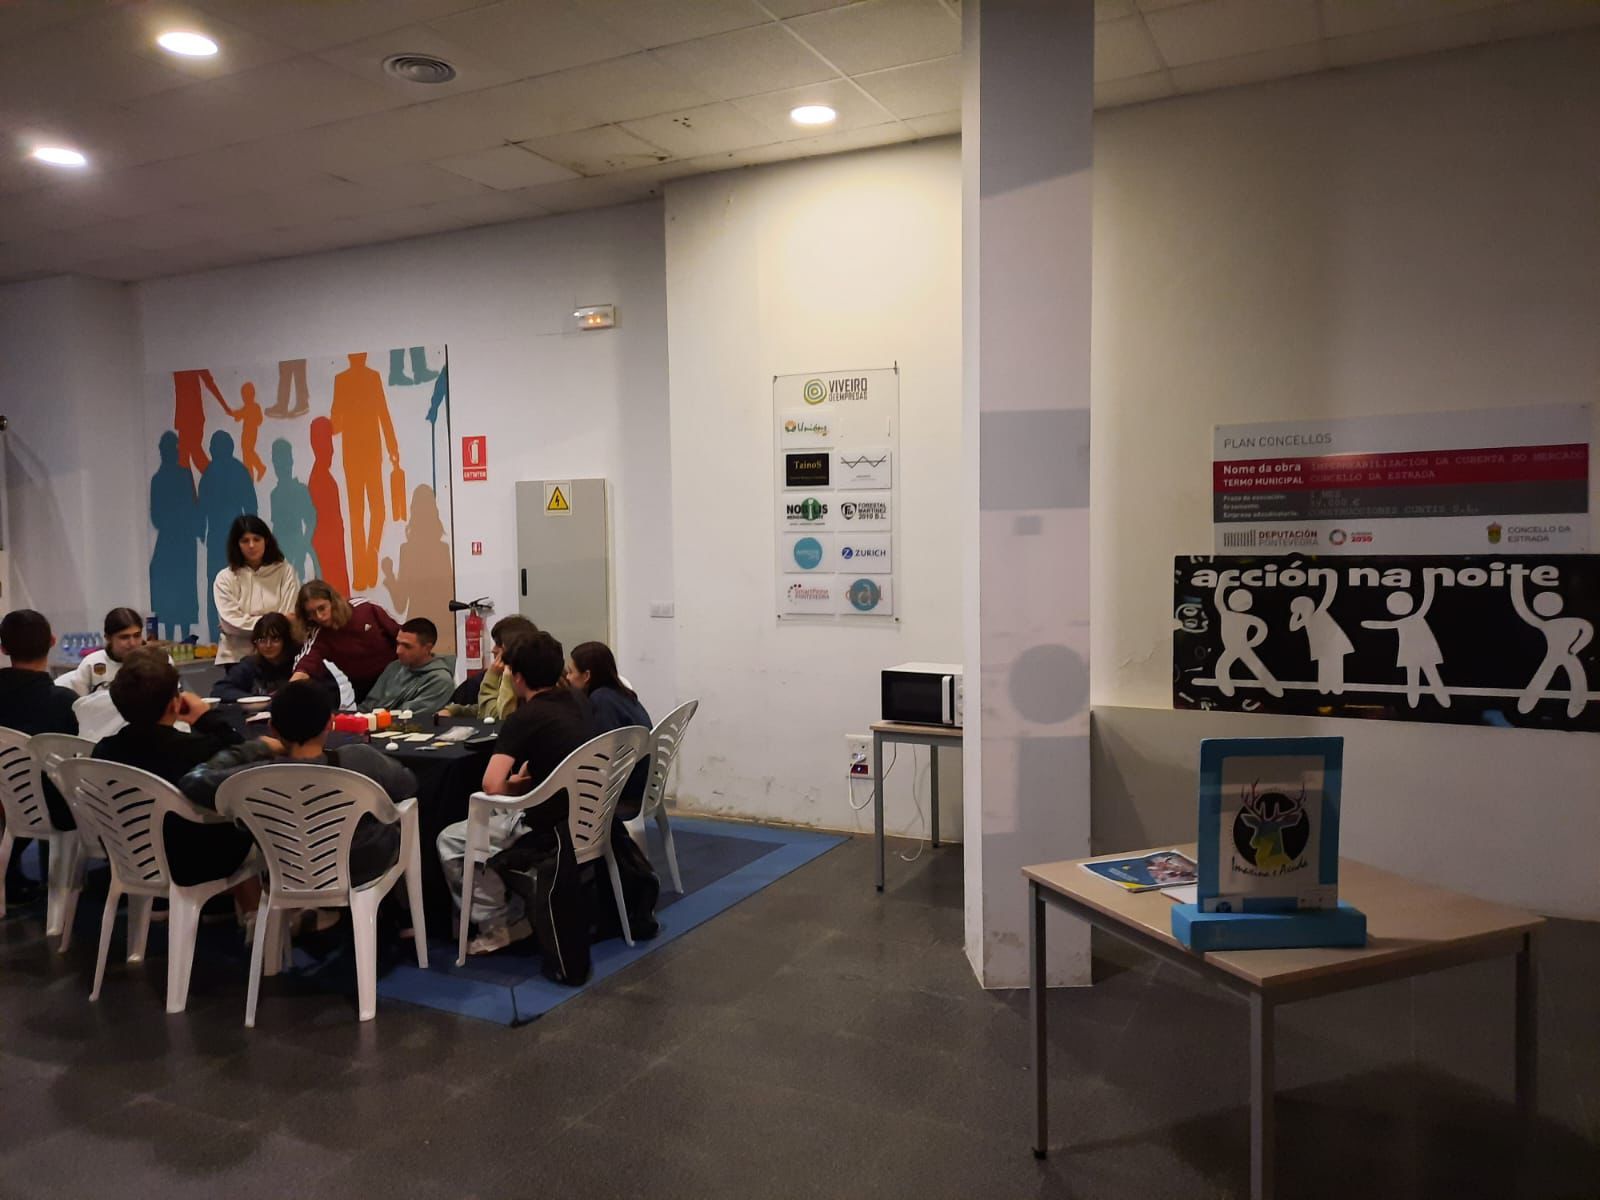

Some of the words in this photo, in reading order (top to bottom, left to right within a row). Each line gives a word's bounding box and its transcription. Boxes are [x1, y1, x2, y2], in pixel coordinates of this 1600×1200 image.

[829, 378, 868, 393] VIVEIRO
[1224, 438, 1256, 449] PLAN
[1259, 433, 1332, 447] CONCELLOS
[1224, 465, 1256, 475] Nome
[1258, 463, 1272, 473] da
[1274, 462, 1302, 473] obra
[1224, 478, 1253, 487] TERMO
[1255, 477, 1304, 486] MUNICIPAL
[1259, 530, 1318, 539] DEPUTACIÓN
[1507, 526, 1556, 534] CONCELLO
[1558, 525, 1571, 533] DA
[1507, 535, 1550, 543] ESTRADA
[855, 549, 886, 557] ZURICH
[1190, 560, 1339, 588] acción
[1348, 567, 1412, 588] na
[1422, 561, 1560, 588] noite
